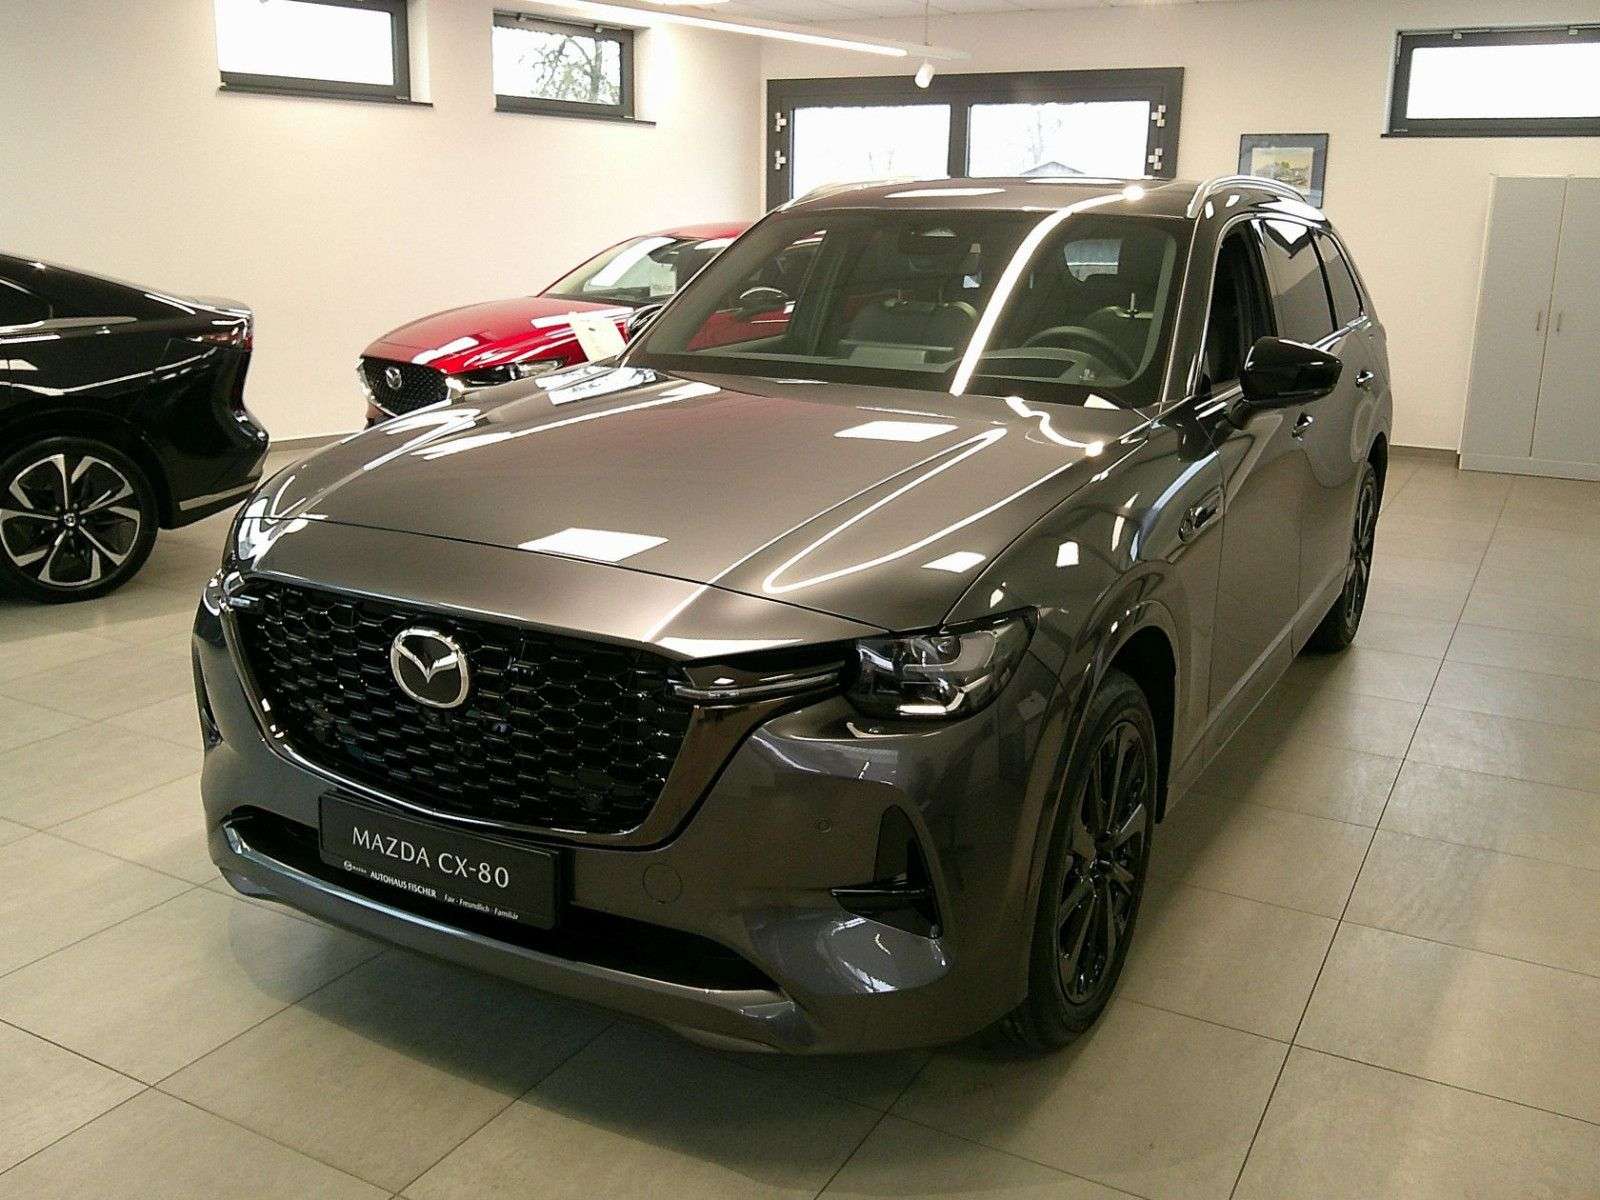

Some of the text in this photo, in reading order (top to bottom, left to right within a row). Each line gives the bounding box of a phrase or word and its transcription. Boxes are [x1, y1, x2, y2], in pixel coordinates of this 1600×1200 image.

[352, 826, 510, 888] MAZDA CX-80
[370, 870, 407, 889] AUTOHAUS
[408, 882, 437, 899] FISCHER
